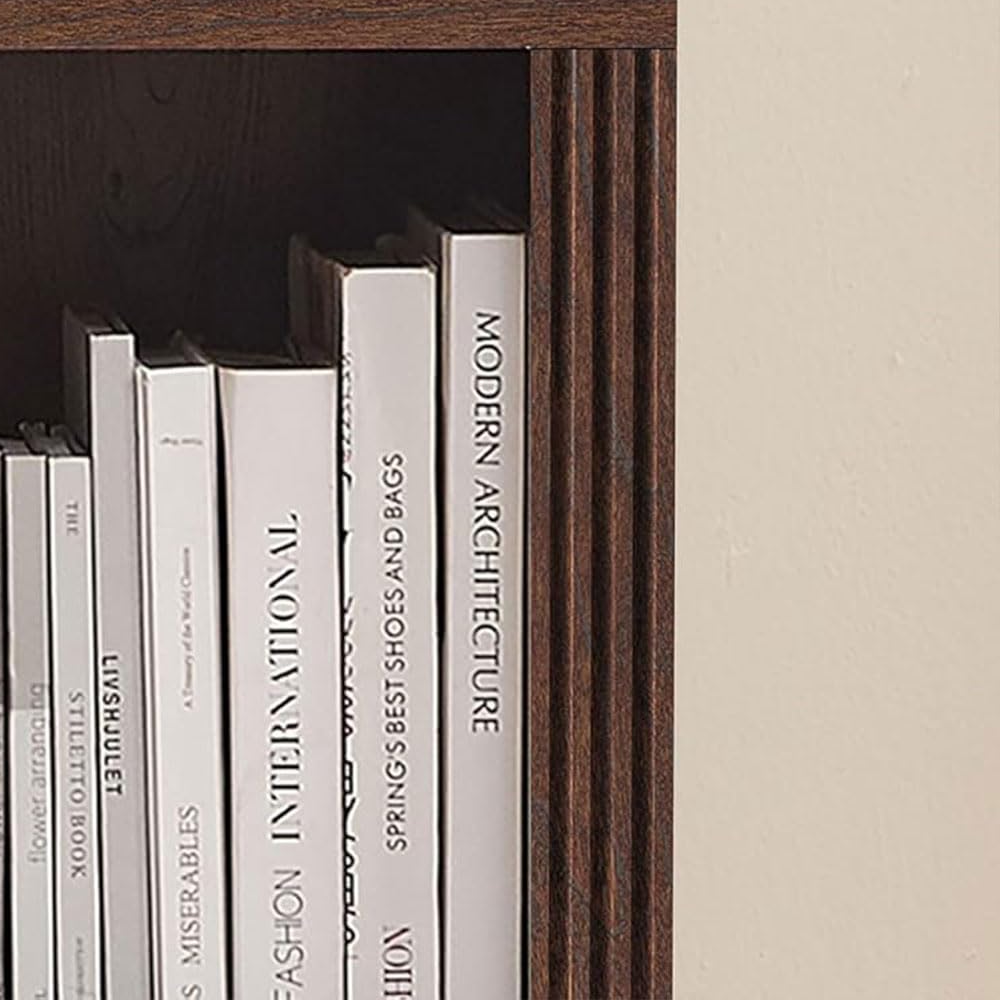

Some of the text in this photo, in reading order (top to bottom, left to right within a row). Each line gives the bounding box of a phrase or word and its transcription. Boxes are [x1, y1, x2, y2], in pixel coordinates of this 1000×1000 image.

[66, 502, 78, 536] THE
[471, 311, 502, 734] MODERN ARCHITECTURE
[102, 654, 123, 796] LIVSHJULET
[268, 513, 301, 841] INTERNATIONAL
[382, 453, 407, 851] SPRING'S BEST SHOES AND BAGS
[28, 797, 48, 864] flower
[68, 689, 87, 879] STILETTO BOOK
[178, 804, 201, 966] MISERABLES
[382, 926, 413, 1000] HION
